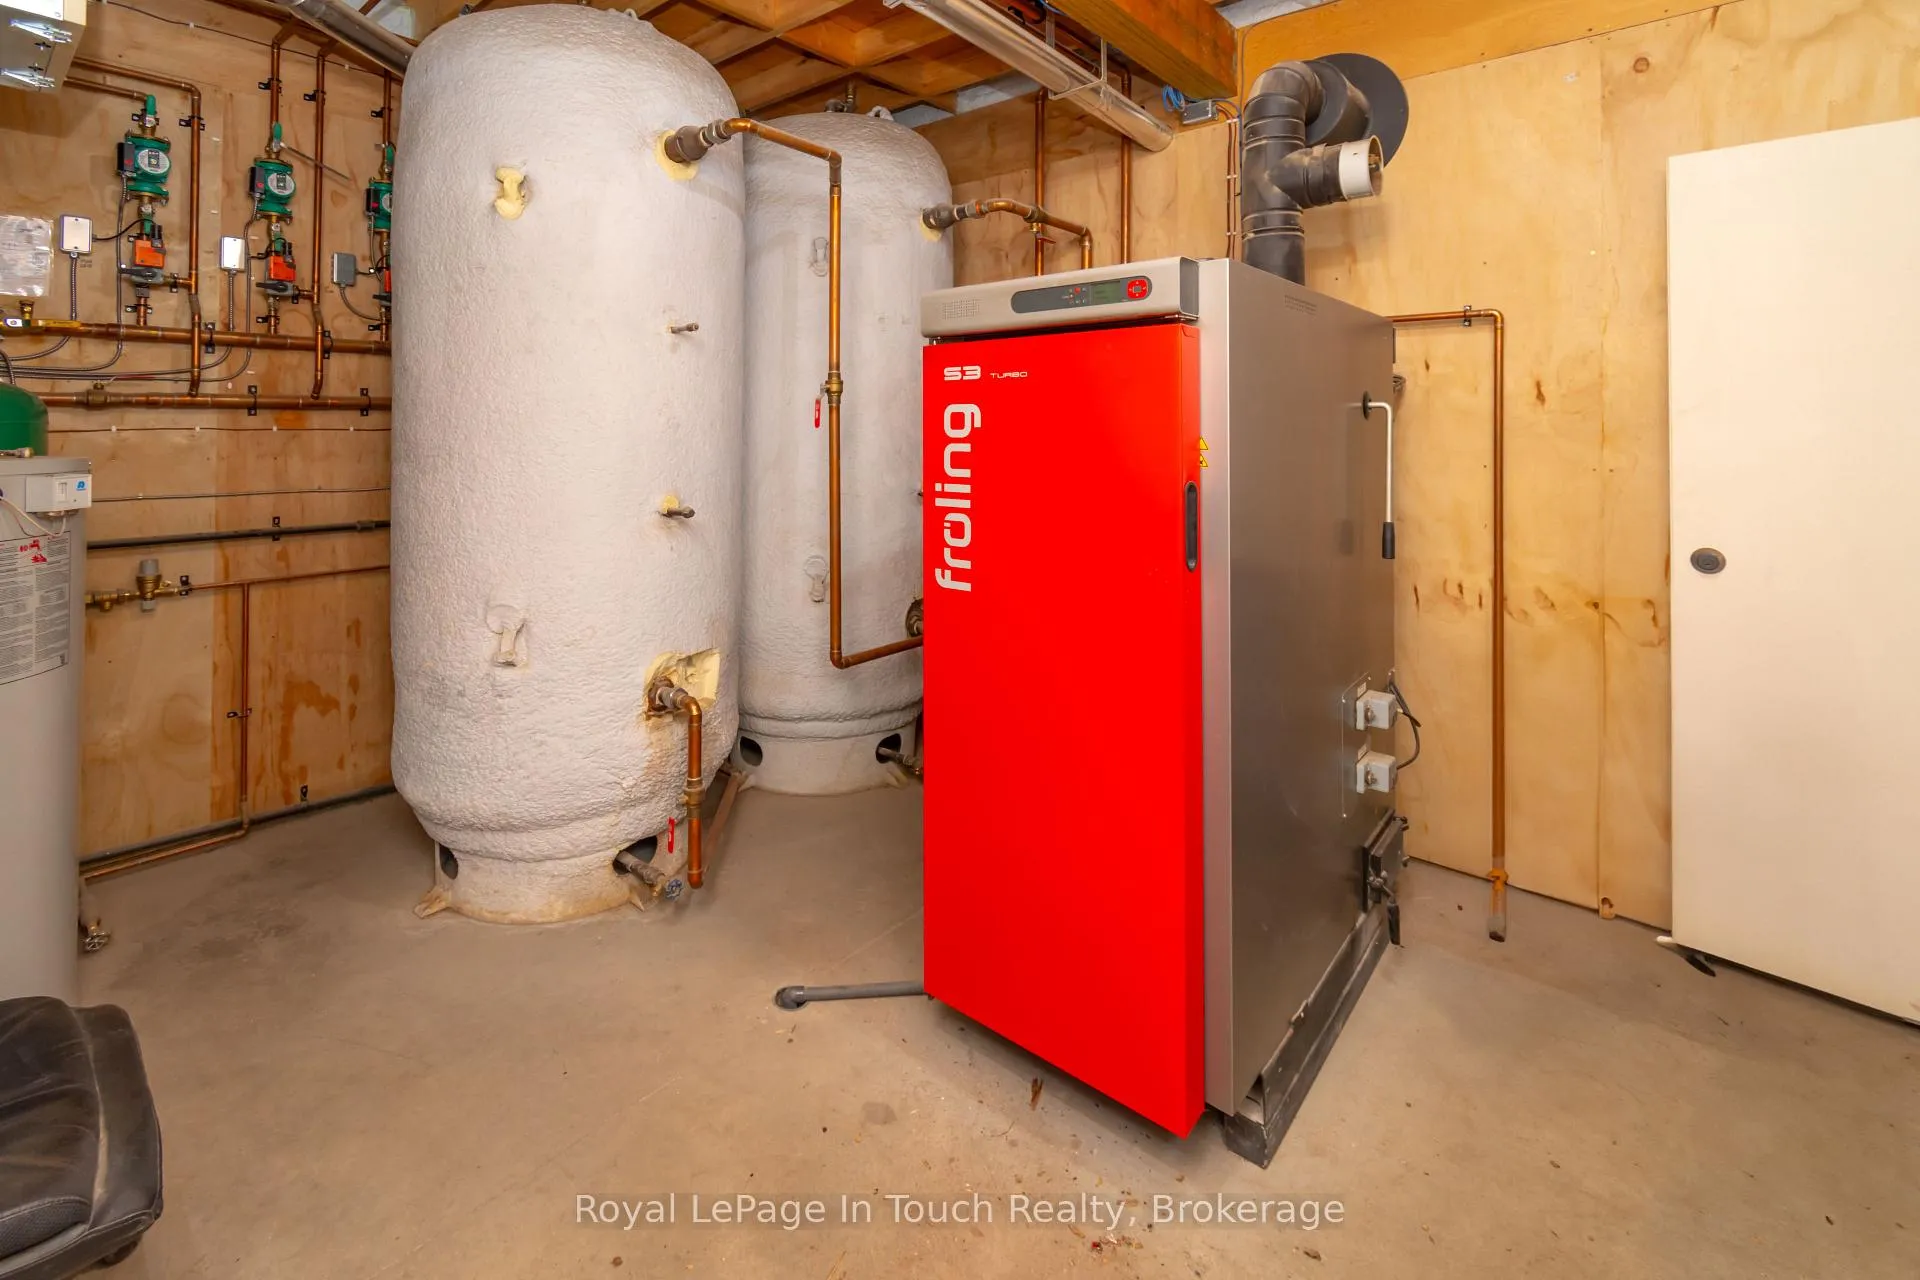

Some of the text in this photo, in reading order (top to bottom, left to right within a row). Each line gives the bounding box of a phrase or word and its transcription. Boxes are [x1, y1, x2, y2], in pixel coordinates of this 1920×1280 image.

[943, 365, 1028, 381] S3 TURBO
[935, 403, 982, 592] fröling
